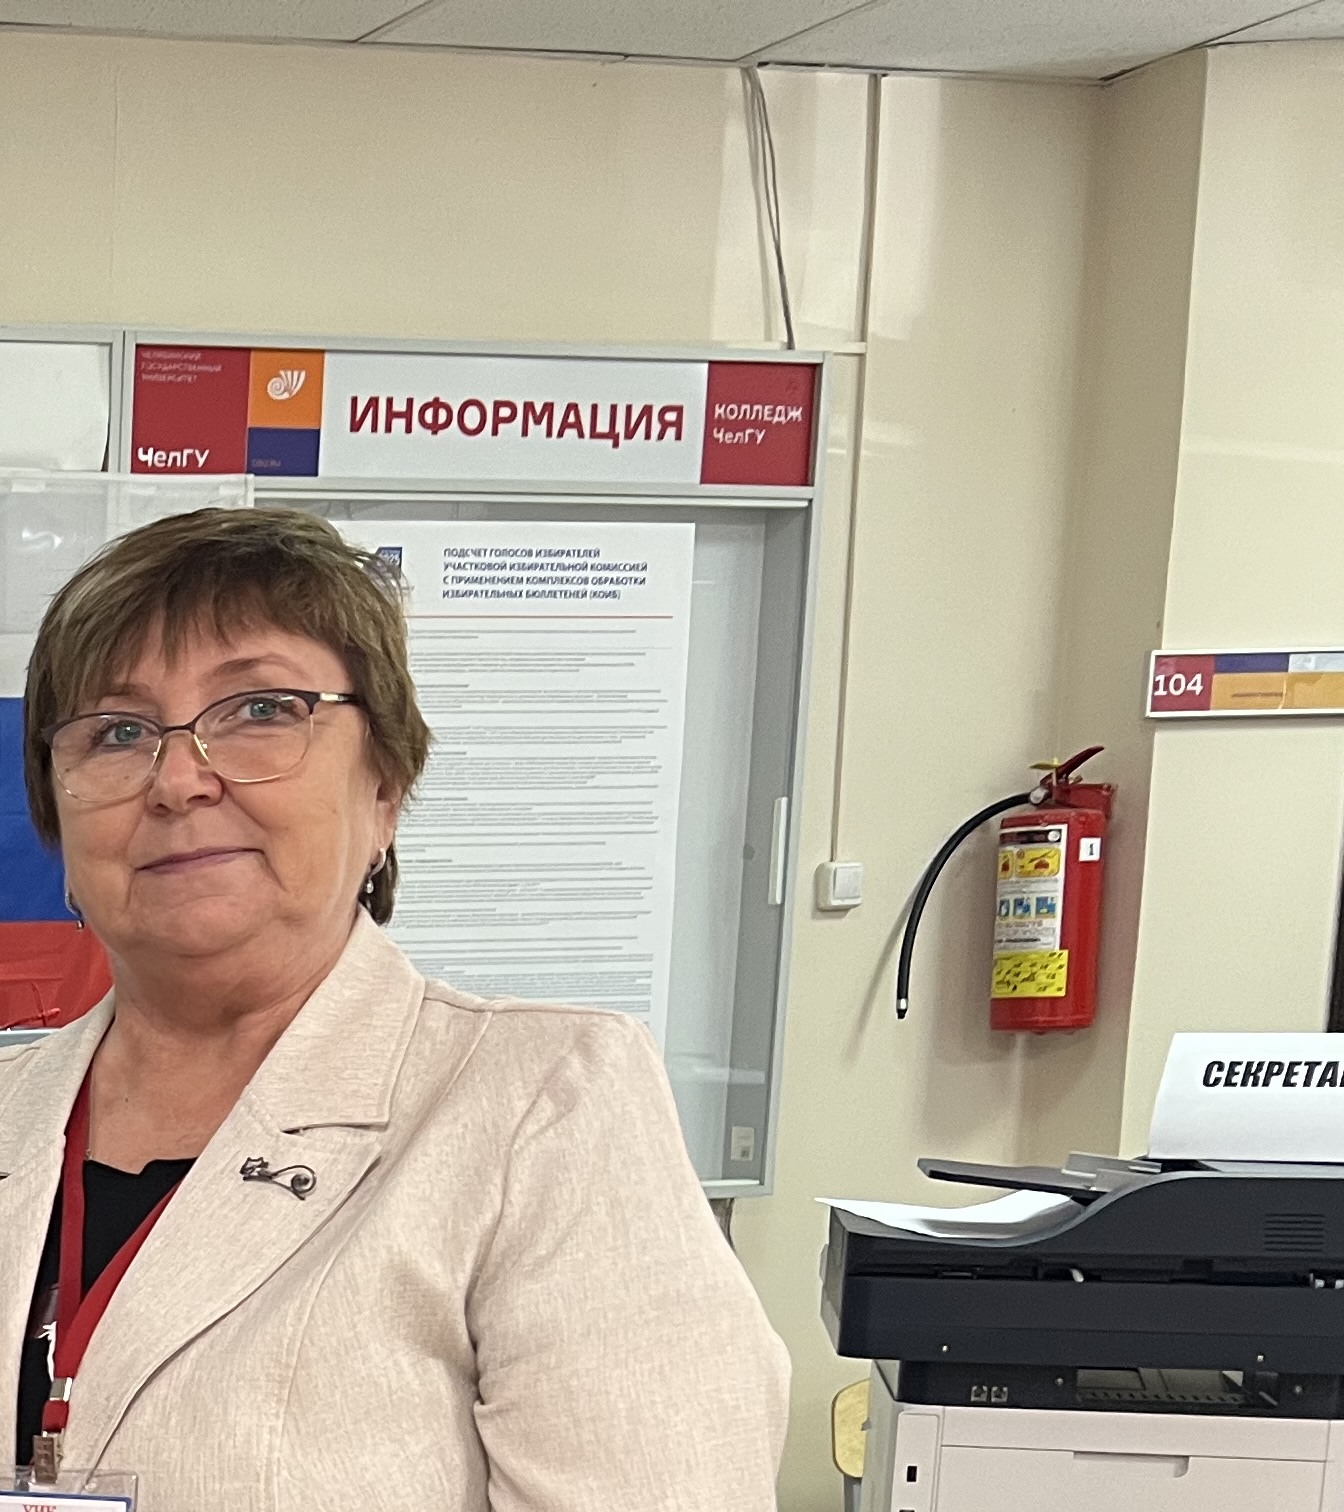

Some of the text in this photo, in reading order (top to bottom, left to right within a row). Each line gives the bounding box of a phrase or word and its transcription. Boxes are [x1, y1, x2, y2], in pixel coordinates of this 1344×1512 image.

[349, 395, 685, 449] ИНФОРМАЦИЯ
[714, 403, 803, 424] КОЛЛЕДЖ
[712, 426, 766, 446] ЧелГУ
[137, 447, 210, 468] ЧелГУ
[444, 547, 600, 559] ПОДСЧЕТ ГОЛОСОВ ИЗБИРАТЕЛЕЙ
[444, 561, 648, 573] УЧАСТКОВОЙ ИЗБИРАТЕЛЬНОЙ КОМИССИЕЙ
[451, 575, 524, 586] ПРИМЕНЕНИЕМ
[526, 576, 589, 586] КОМПЛЕКСОВ
[591, 576, 646, 586] ОБРАБОТКИ
[442, 588, 621, 600] ИЗБИРАТЕЛЬНЫХ БЮЛЛЕТЕНЕЙ (КОИБ)
[1154, 673, 1204, 697] 104
[1202, 1060, 1344, 1088] СЕКРЕТА
